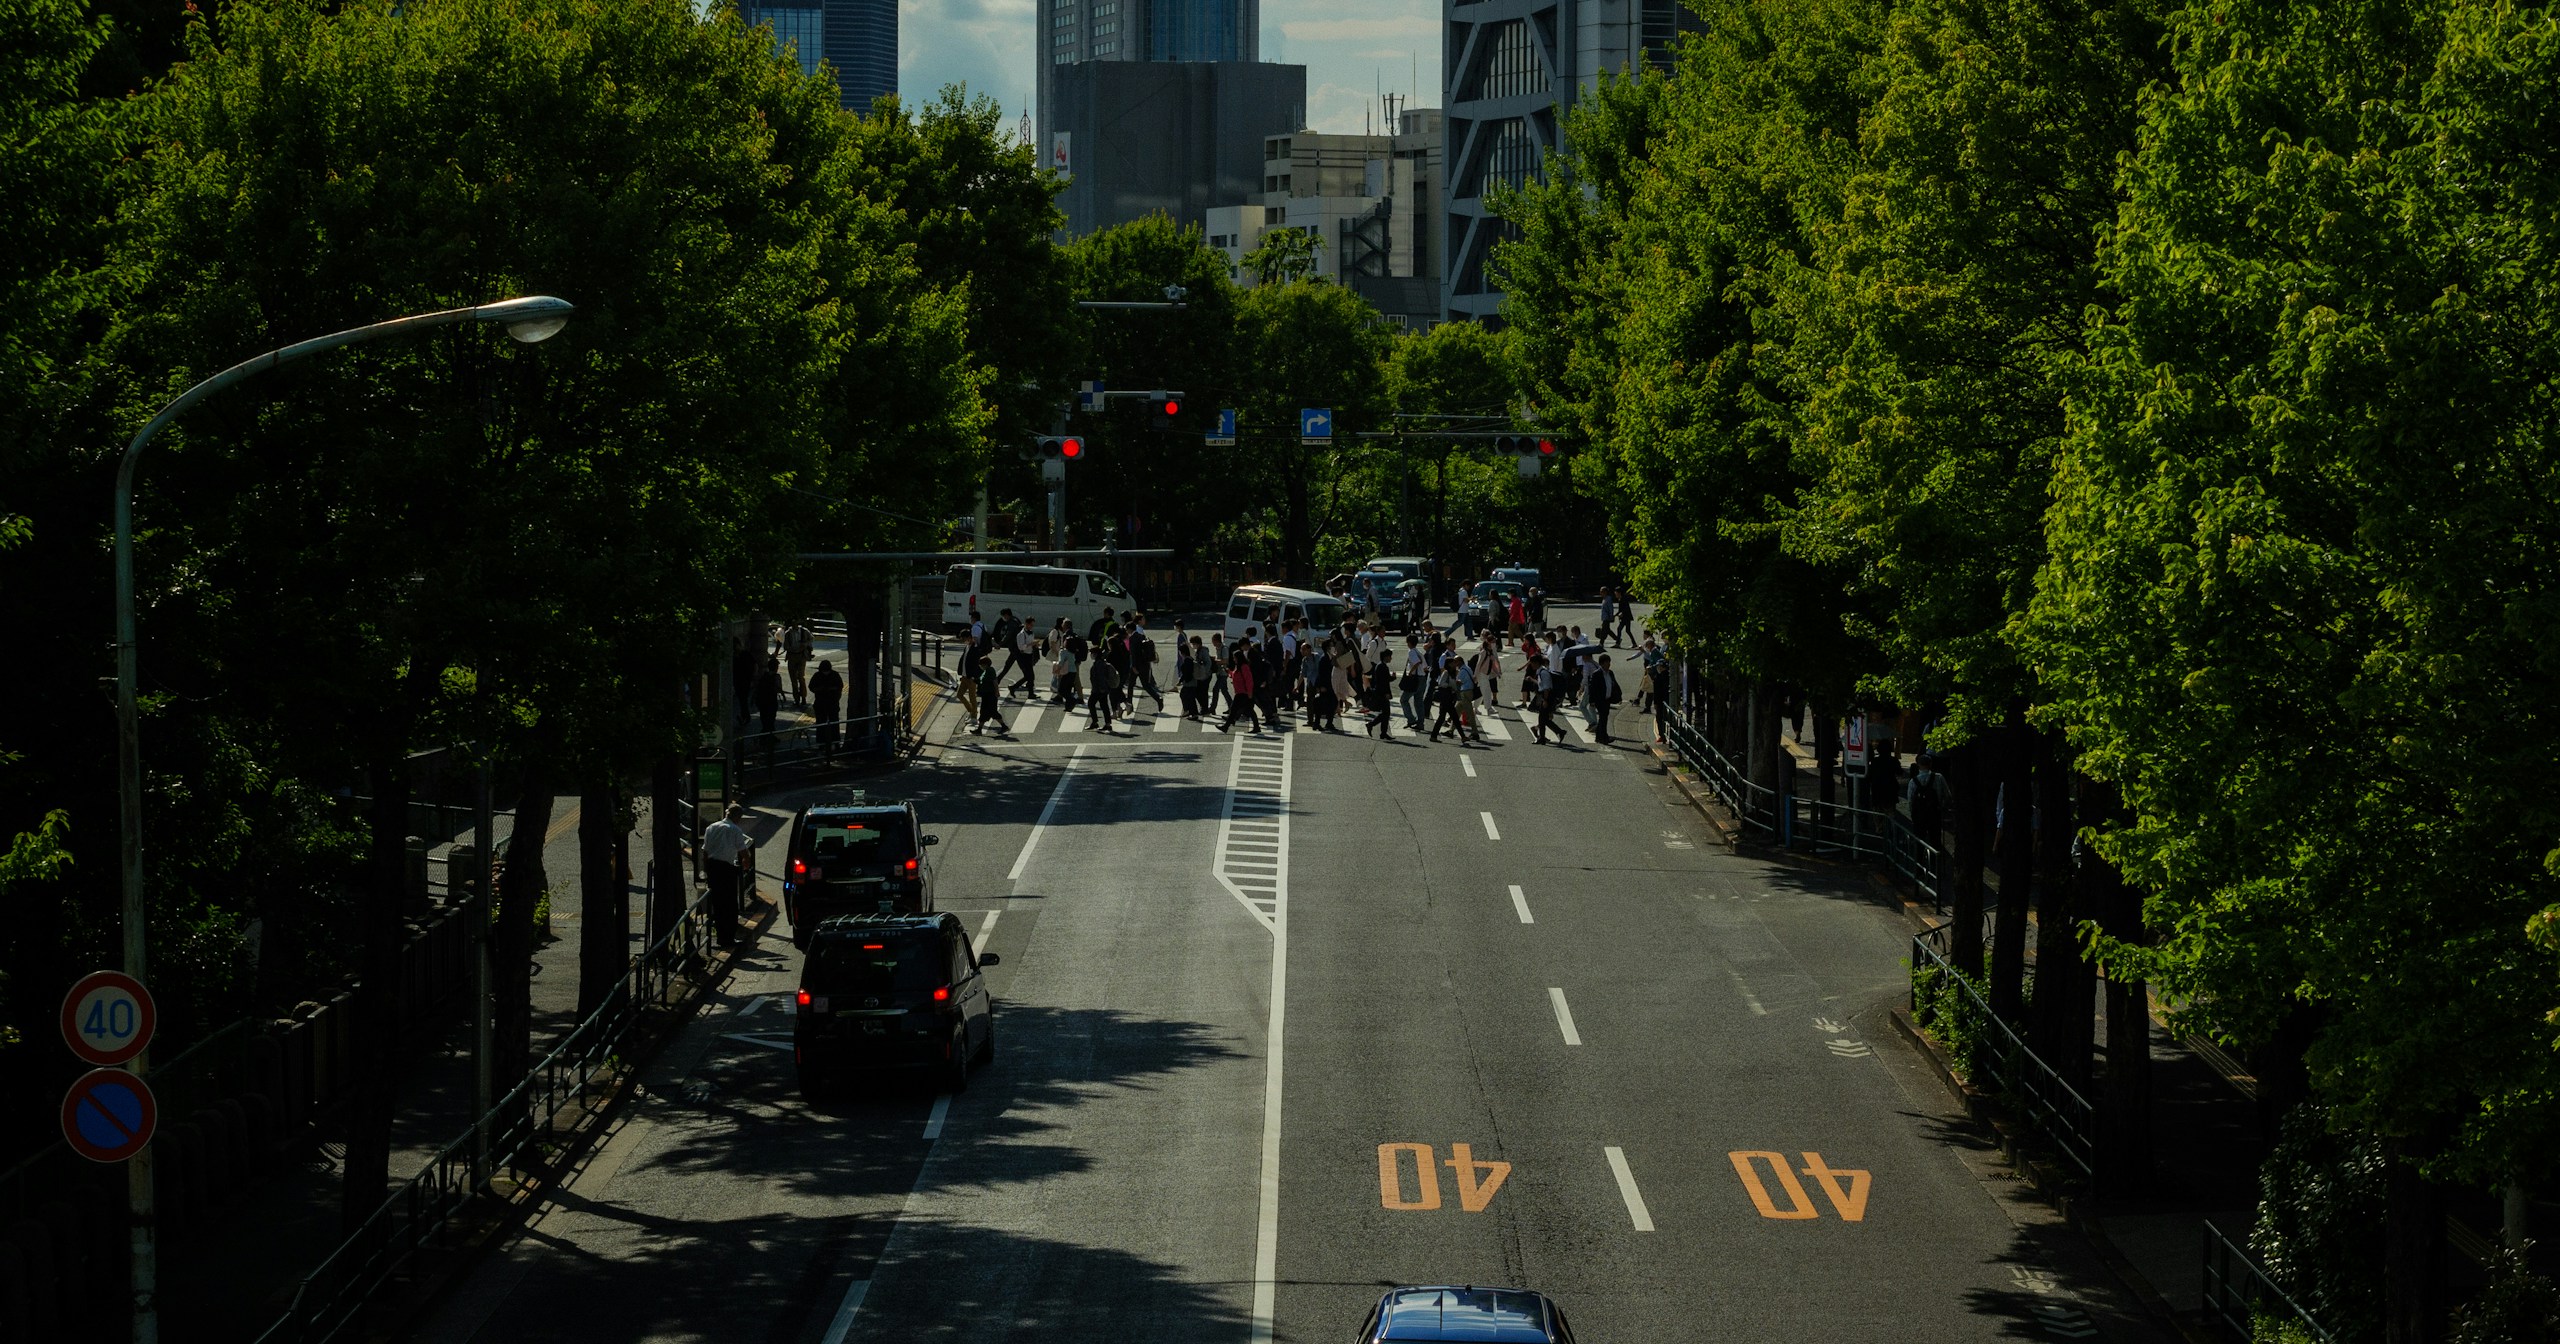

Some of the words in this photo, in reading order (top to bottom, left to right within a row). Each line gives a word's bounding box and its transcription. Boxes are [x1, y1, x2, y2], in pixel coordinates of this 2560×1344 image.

[85, 999, 134, 1039] 40
[1378, 1142, 1512, 1212] 40
[1729, 1150, 1873, 1222] 40
